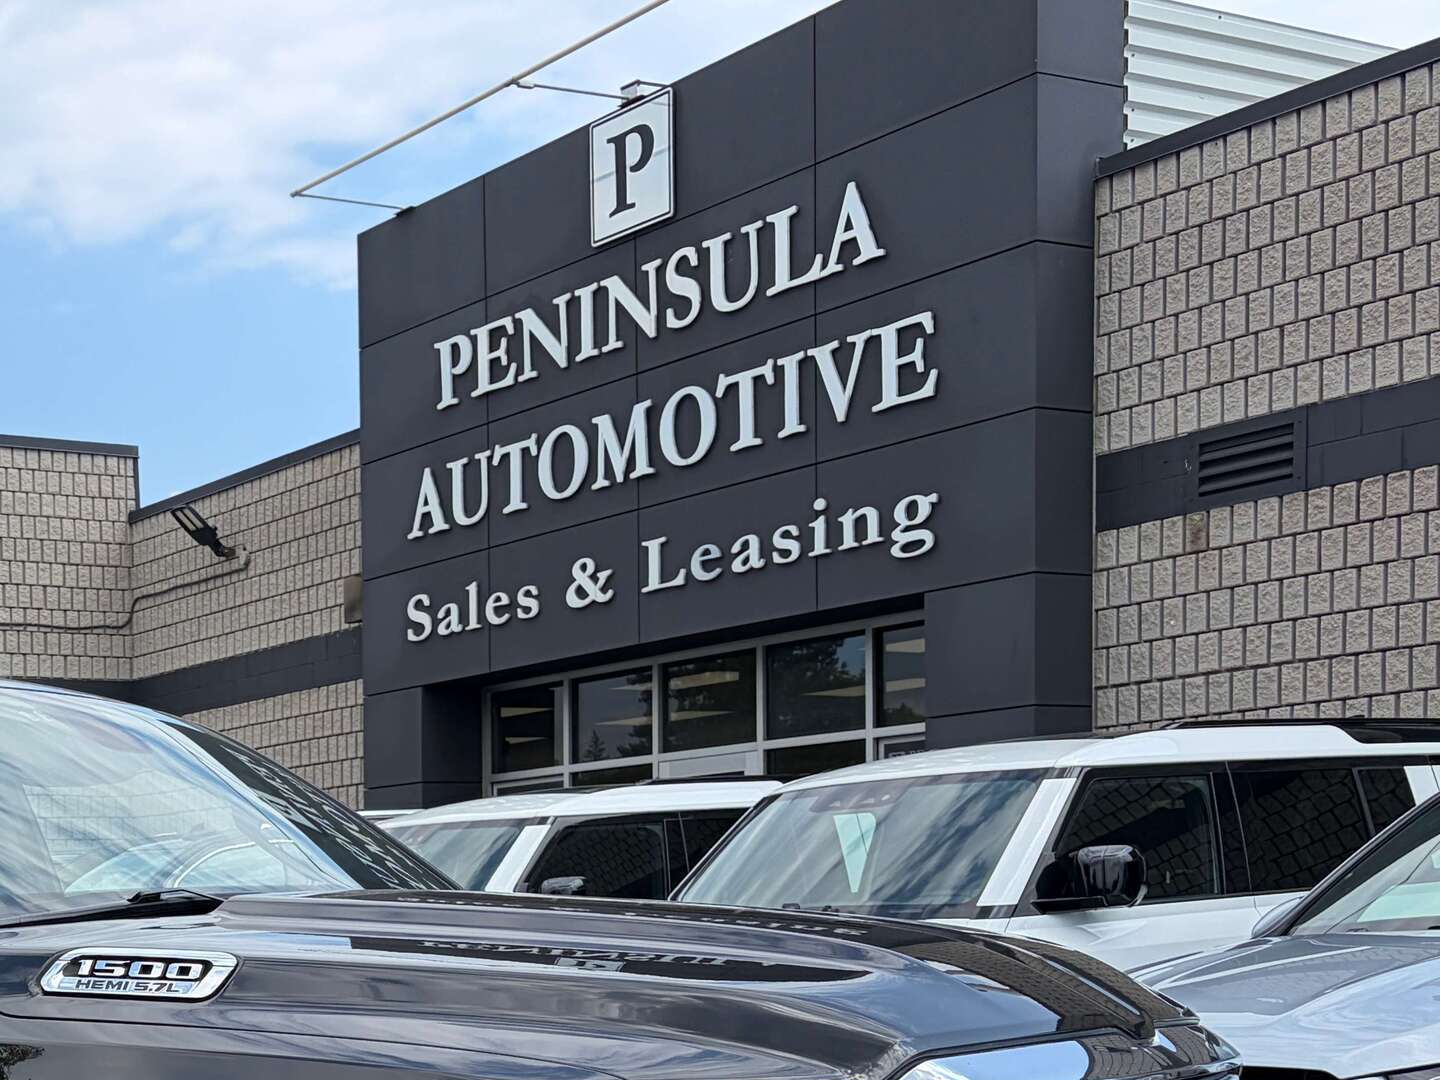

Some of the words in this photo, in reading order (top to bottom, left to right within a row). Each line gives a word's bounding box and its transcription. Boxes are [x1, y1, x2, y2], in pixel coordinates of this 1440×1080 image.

[606, 122, 655, 218] P
[434, 180, 886, 410] PENINSULA
[406, 311, 939, 539] AUTOMOTIVE
[406, 581, 540, 642] Sales
[565, 556, 615, 609] &
[641, 492, 939, 593] Leasing
[75, 979, 129, 991] HEMI
[133, 980, 178, 993] 5.7L
[77, 959, 204, 979] 1500
